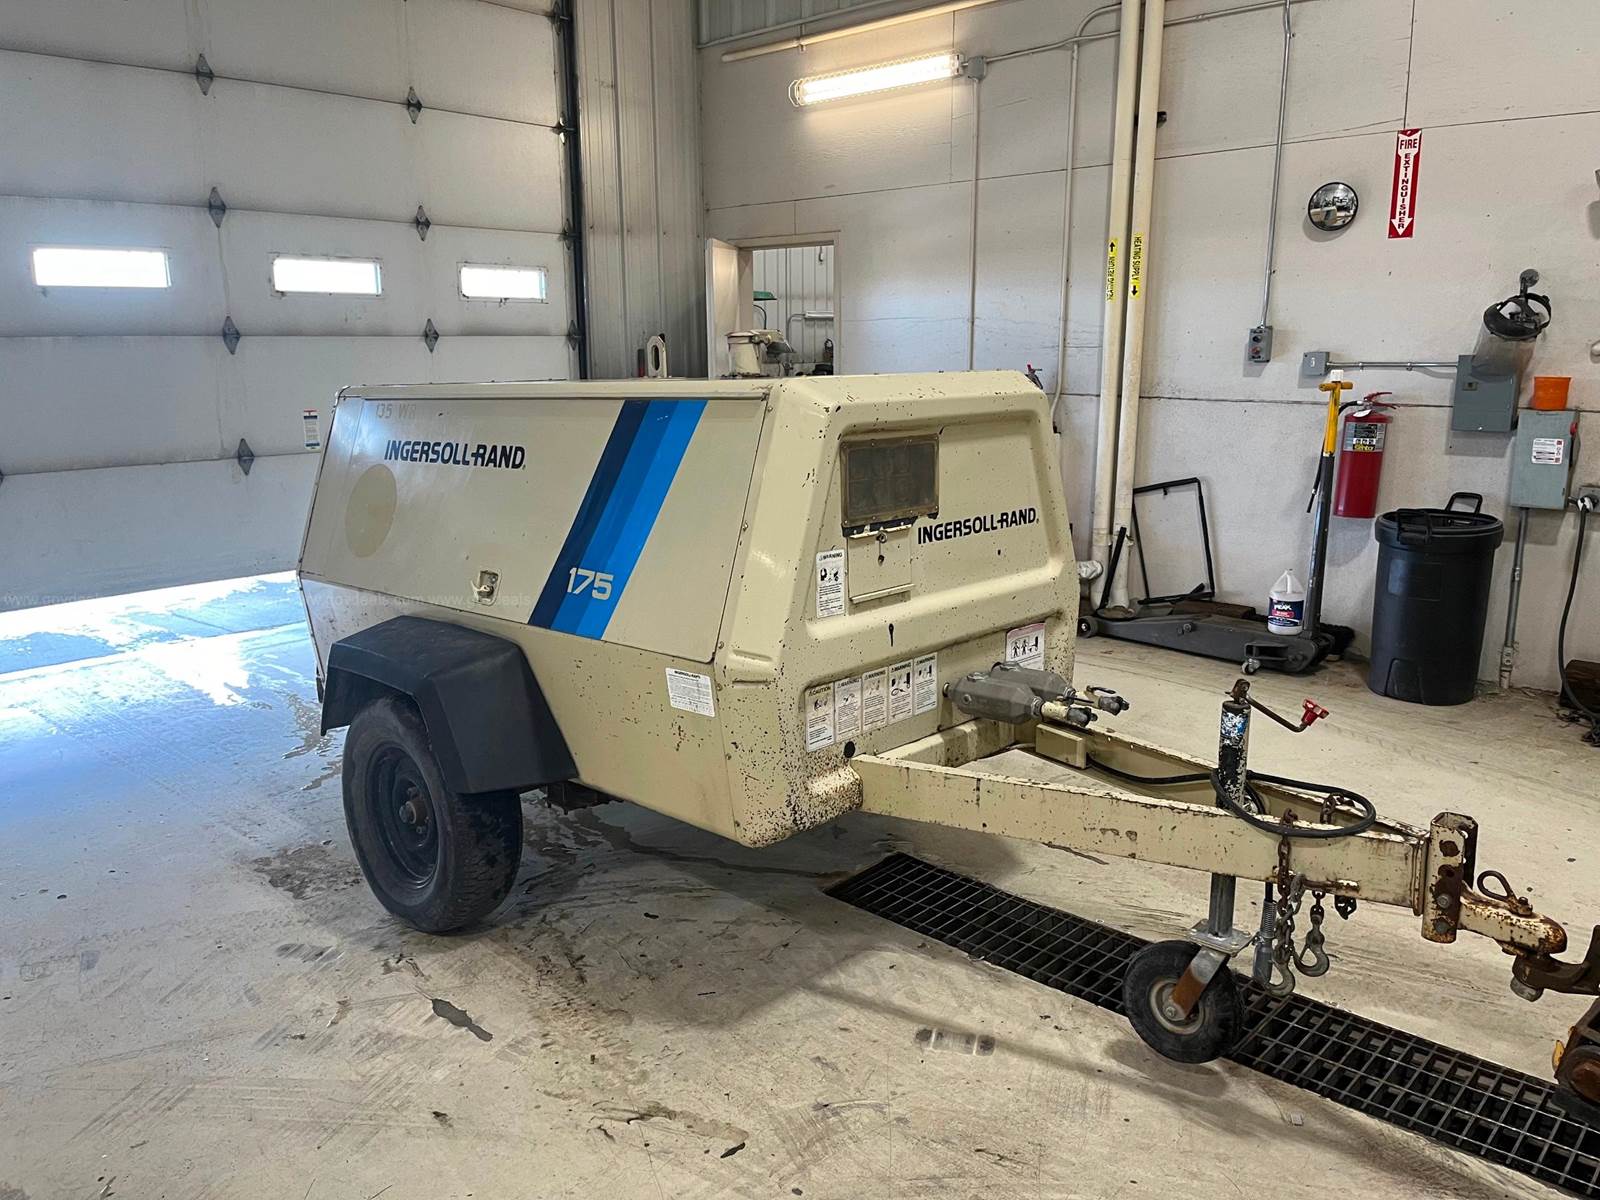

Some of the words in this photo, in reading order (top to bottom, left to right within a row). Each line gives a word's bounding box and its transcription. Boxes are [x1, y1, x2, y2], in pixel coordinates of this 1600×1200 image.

[1399, 138, 1418, 150] FIRE
[1397, 152, 1411, 230] EXTINGUISHER
[1132, 236, 1142, 260] HEATING
[1131, 260, 1141, 281] SUPPLY
[384, 439, 526, 470] INGERSOLL-RAND
[917, 506, 1037, 545] INGERSOLL-RAND
[566, 567, 614, 601] 175
